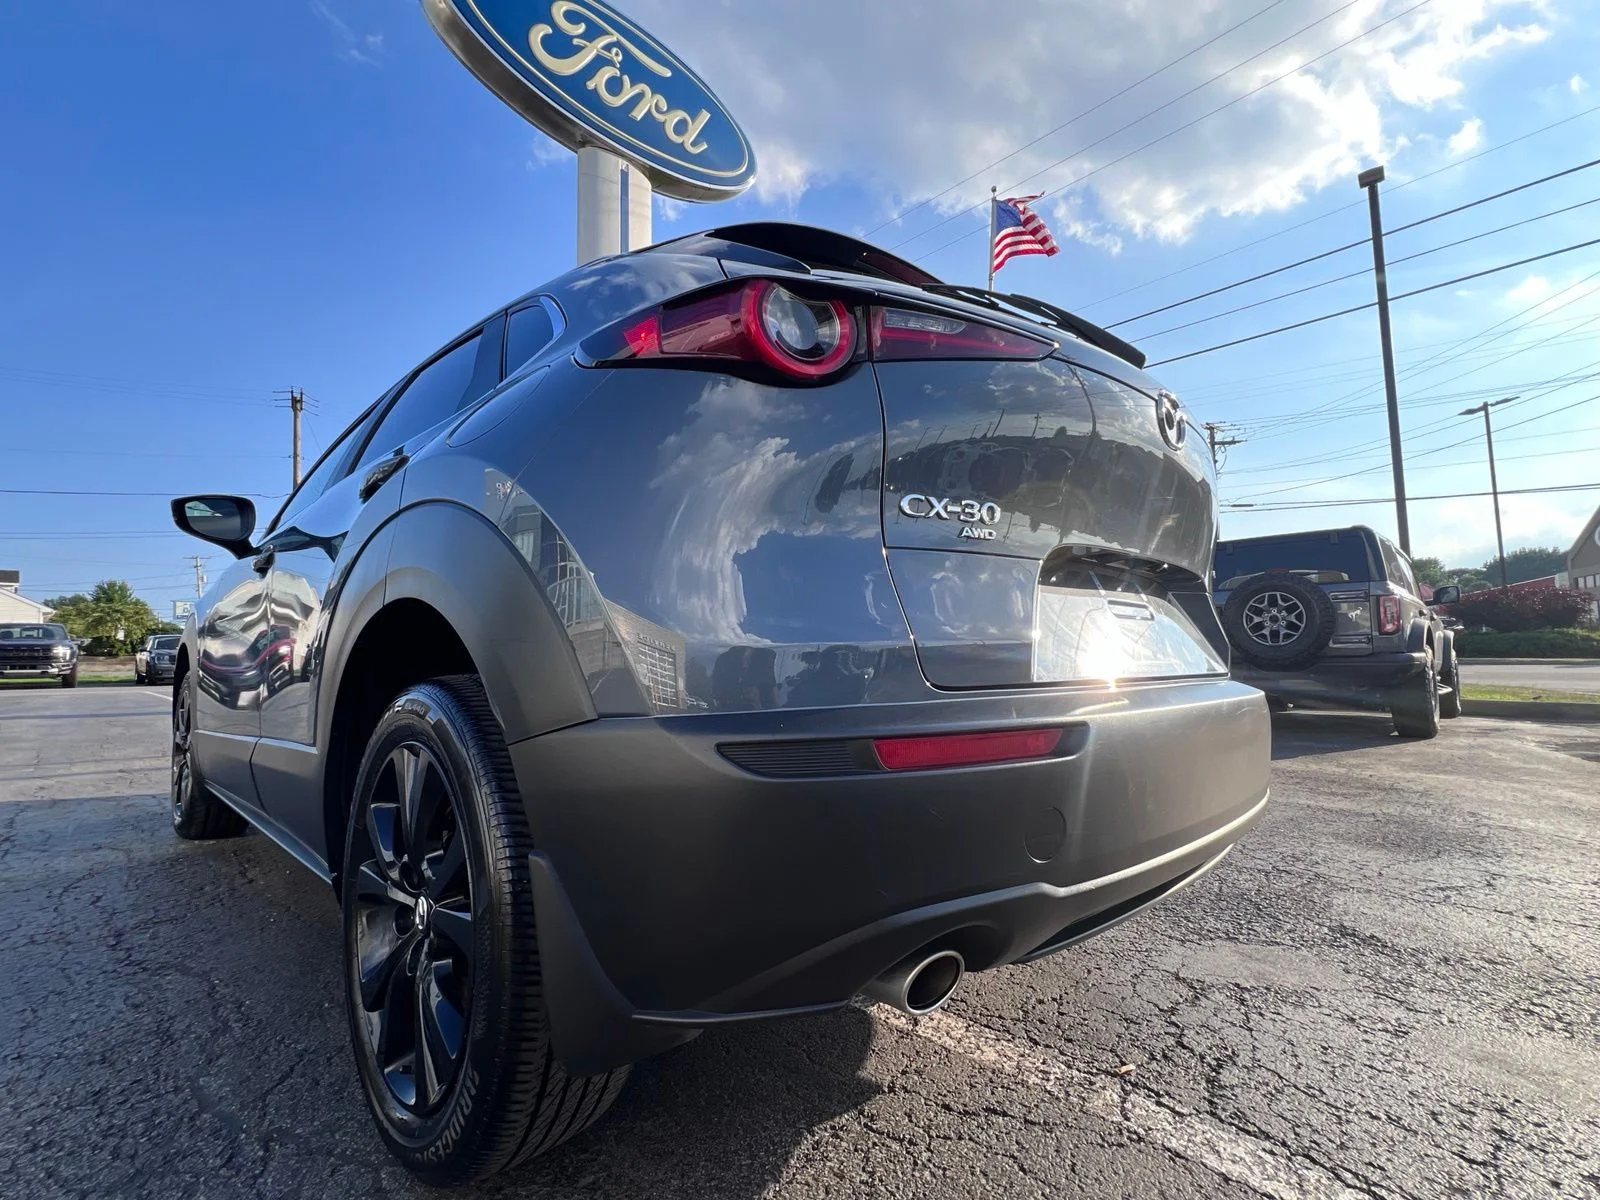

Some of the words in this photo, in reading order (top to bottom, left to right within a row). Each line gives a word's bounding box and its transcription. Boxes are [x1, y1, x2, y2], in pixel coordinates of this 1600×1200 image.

[529, 0, 711, 155] Ford
[899, 493, 1001, 525] CX-30
[959, 526, 997, 541] AWD
